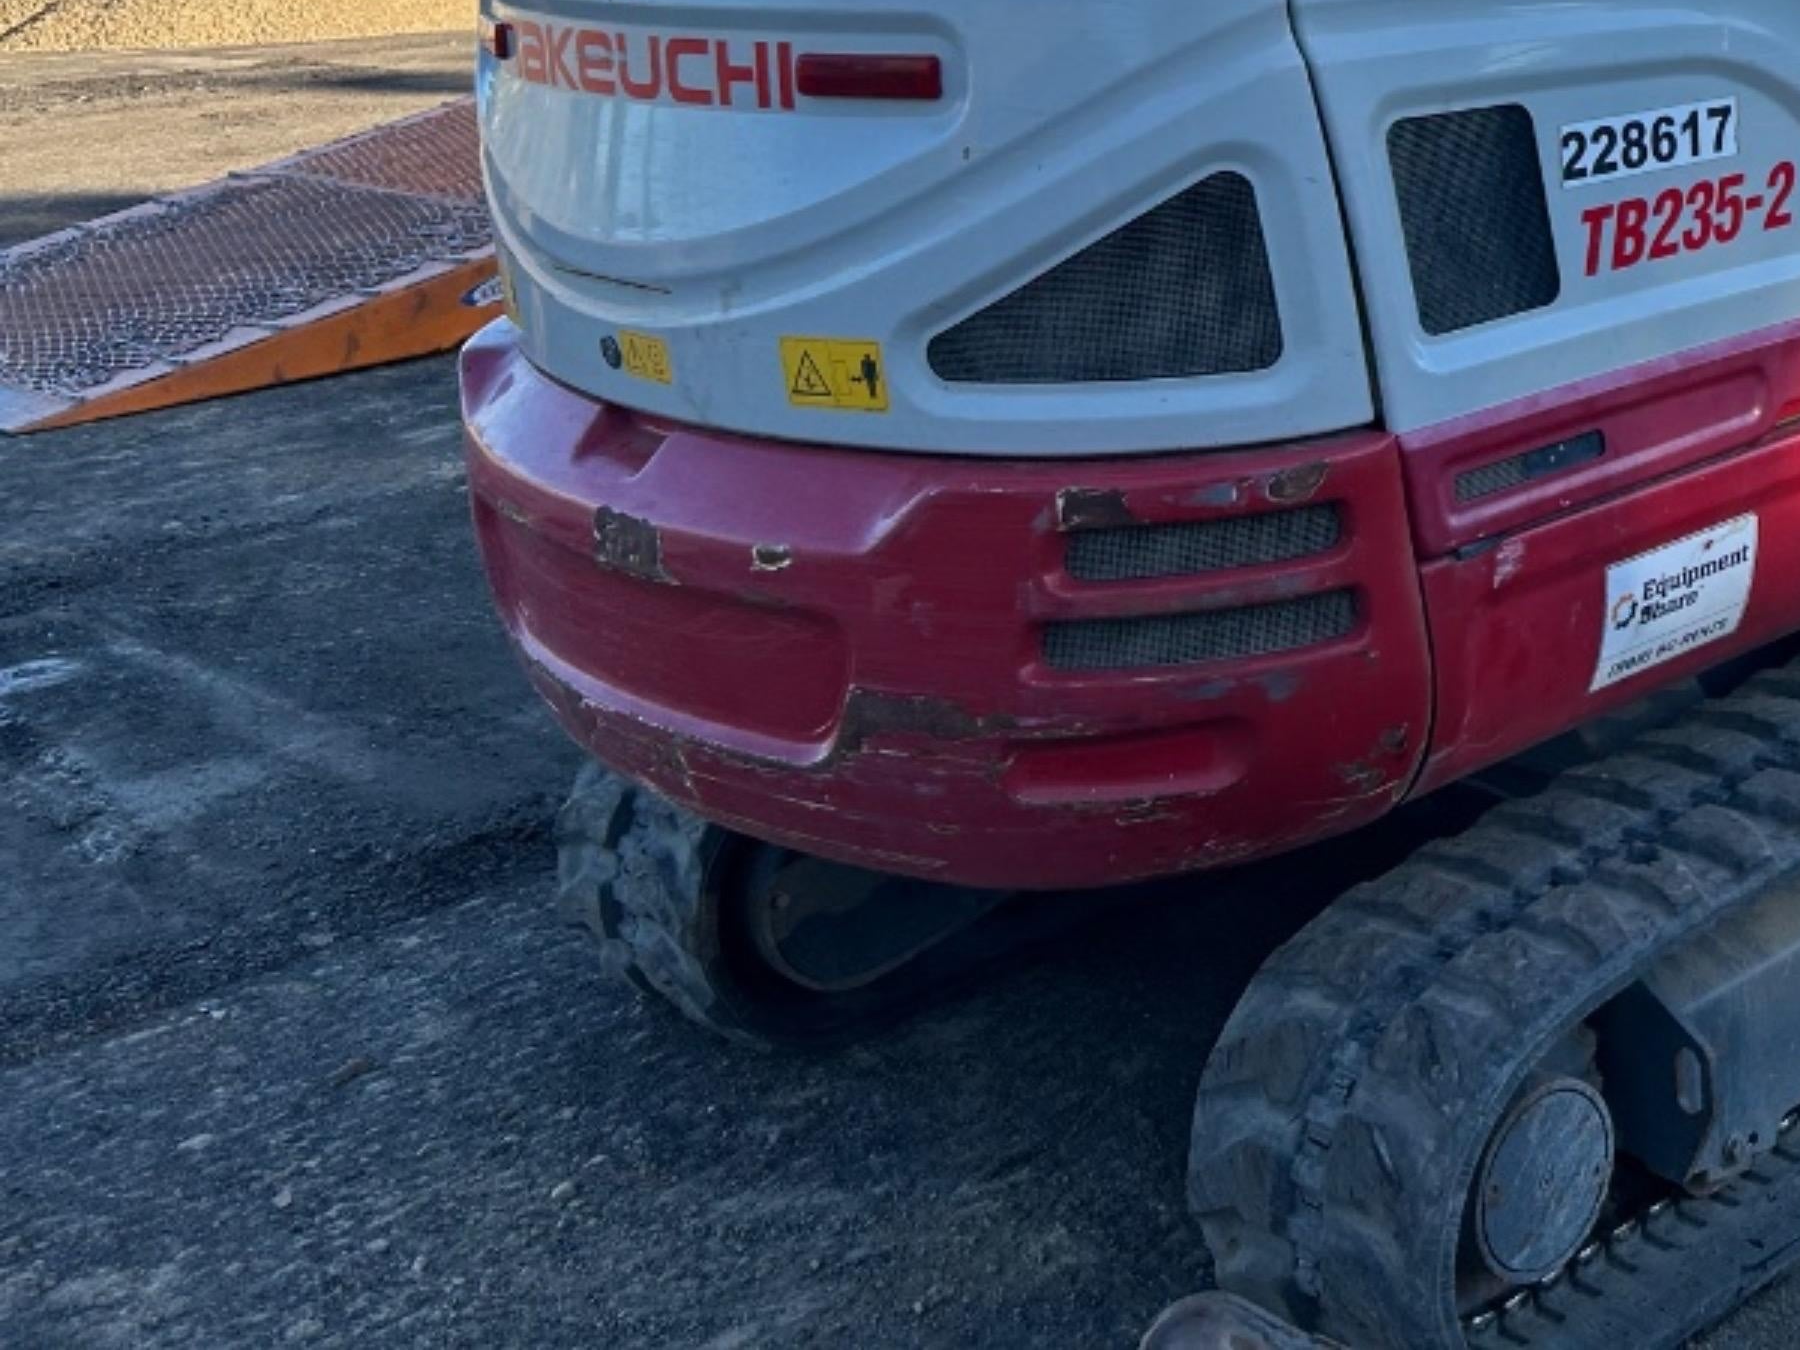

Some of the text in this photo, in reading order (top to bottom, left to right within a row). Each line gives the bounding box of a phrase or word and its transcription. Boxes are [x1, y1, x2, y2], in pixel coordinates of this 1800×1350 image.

[1561, 104, 1733, 181] 228617
[1580, 160, 1796, 277] TB235-2
[1642, 544, 1750, 601] Equipment
